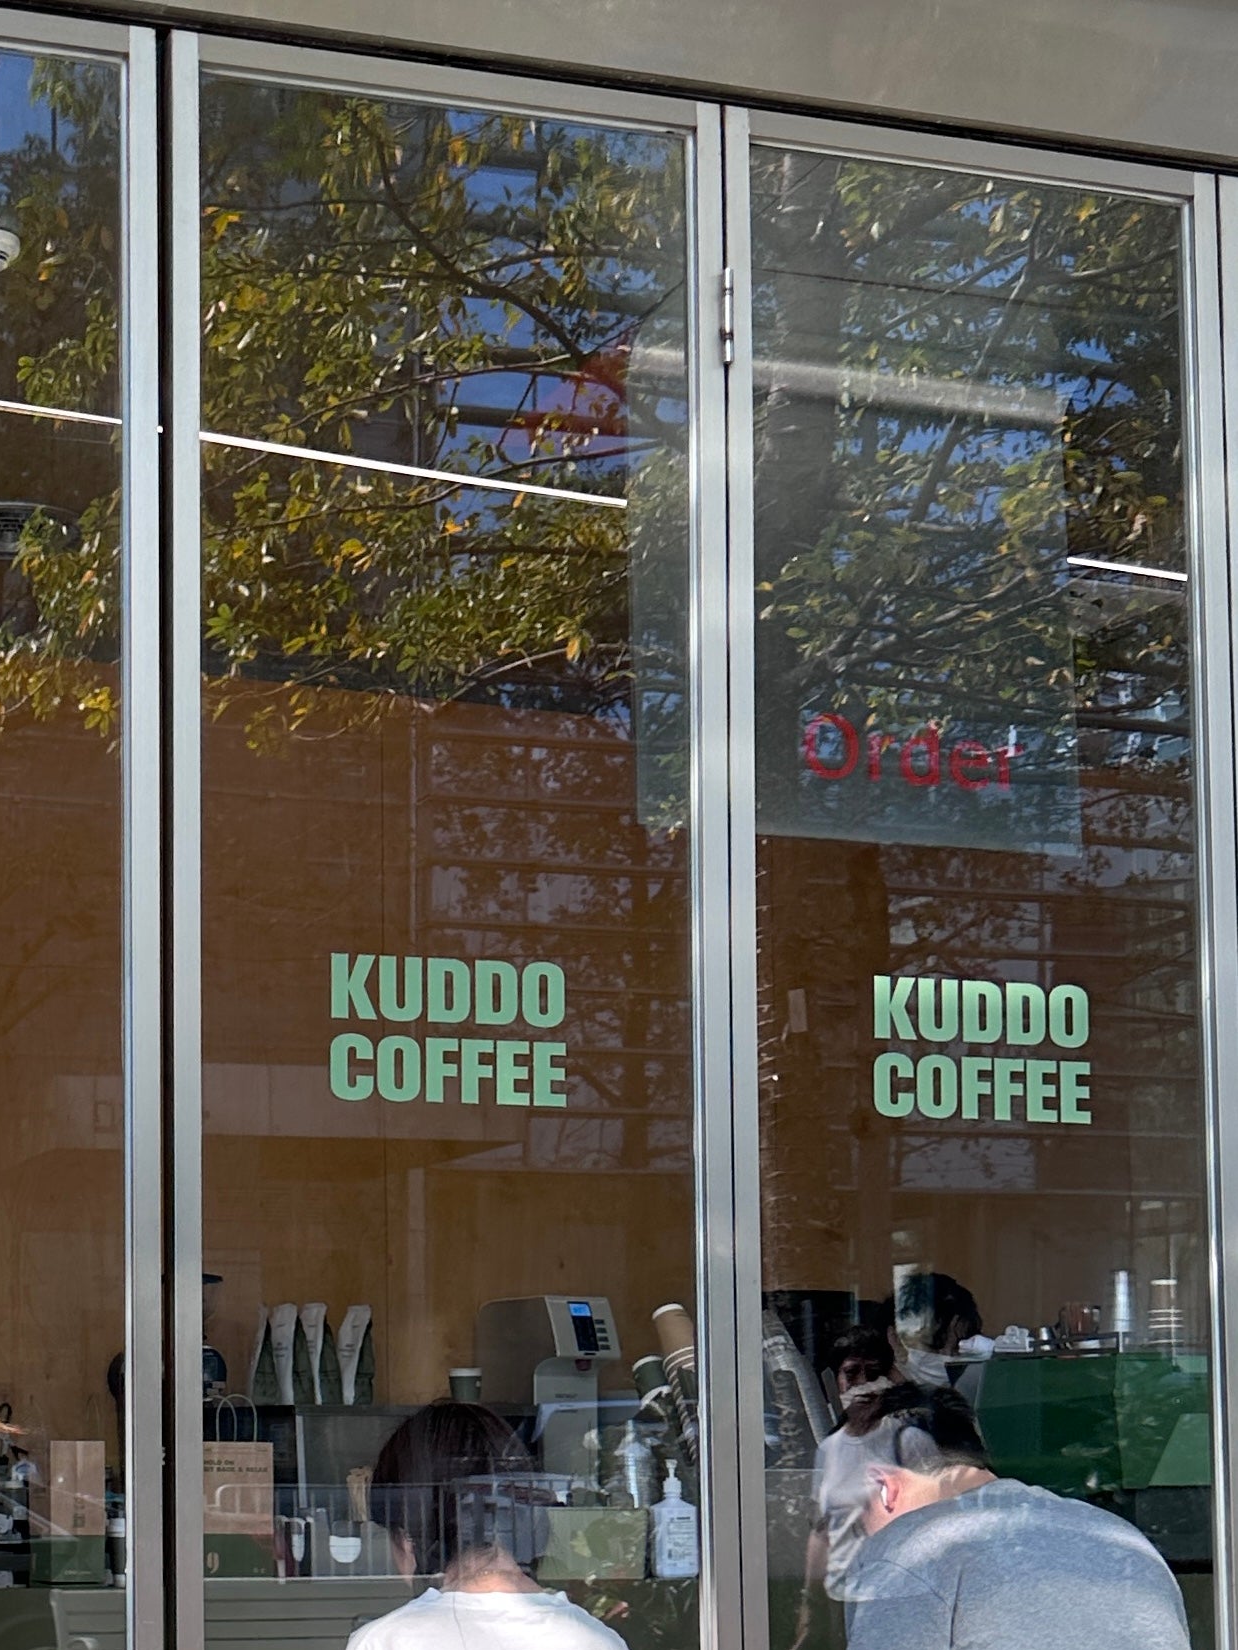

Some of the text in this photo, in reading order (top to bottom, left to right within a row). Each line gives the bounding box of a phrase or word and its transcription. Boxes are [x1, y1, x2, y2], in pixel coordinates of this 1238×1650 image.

[803, 712, 1025, 791] Order
[330, 952, 566, 1029] KUDDO
[873, 975, 1090, 1049] KUDDO
[329, 1032, 567, 1108] COFFEE
[873, 1052, 1092, 1125] COFFEE
